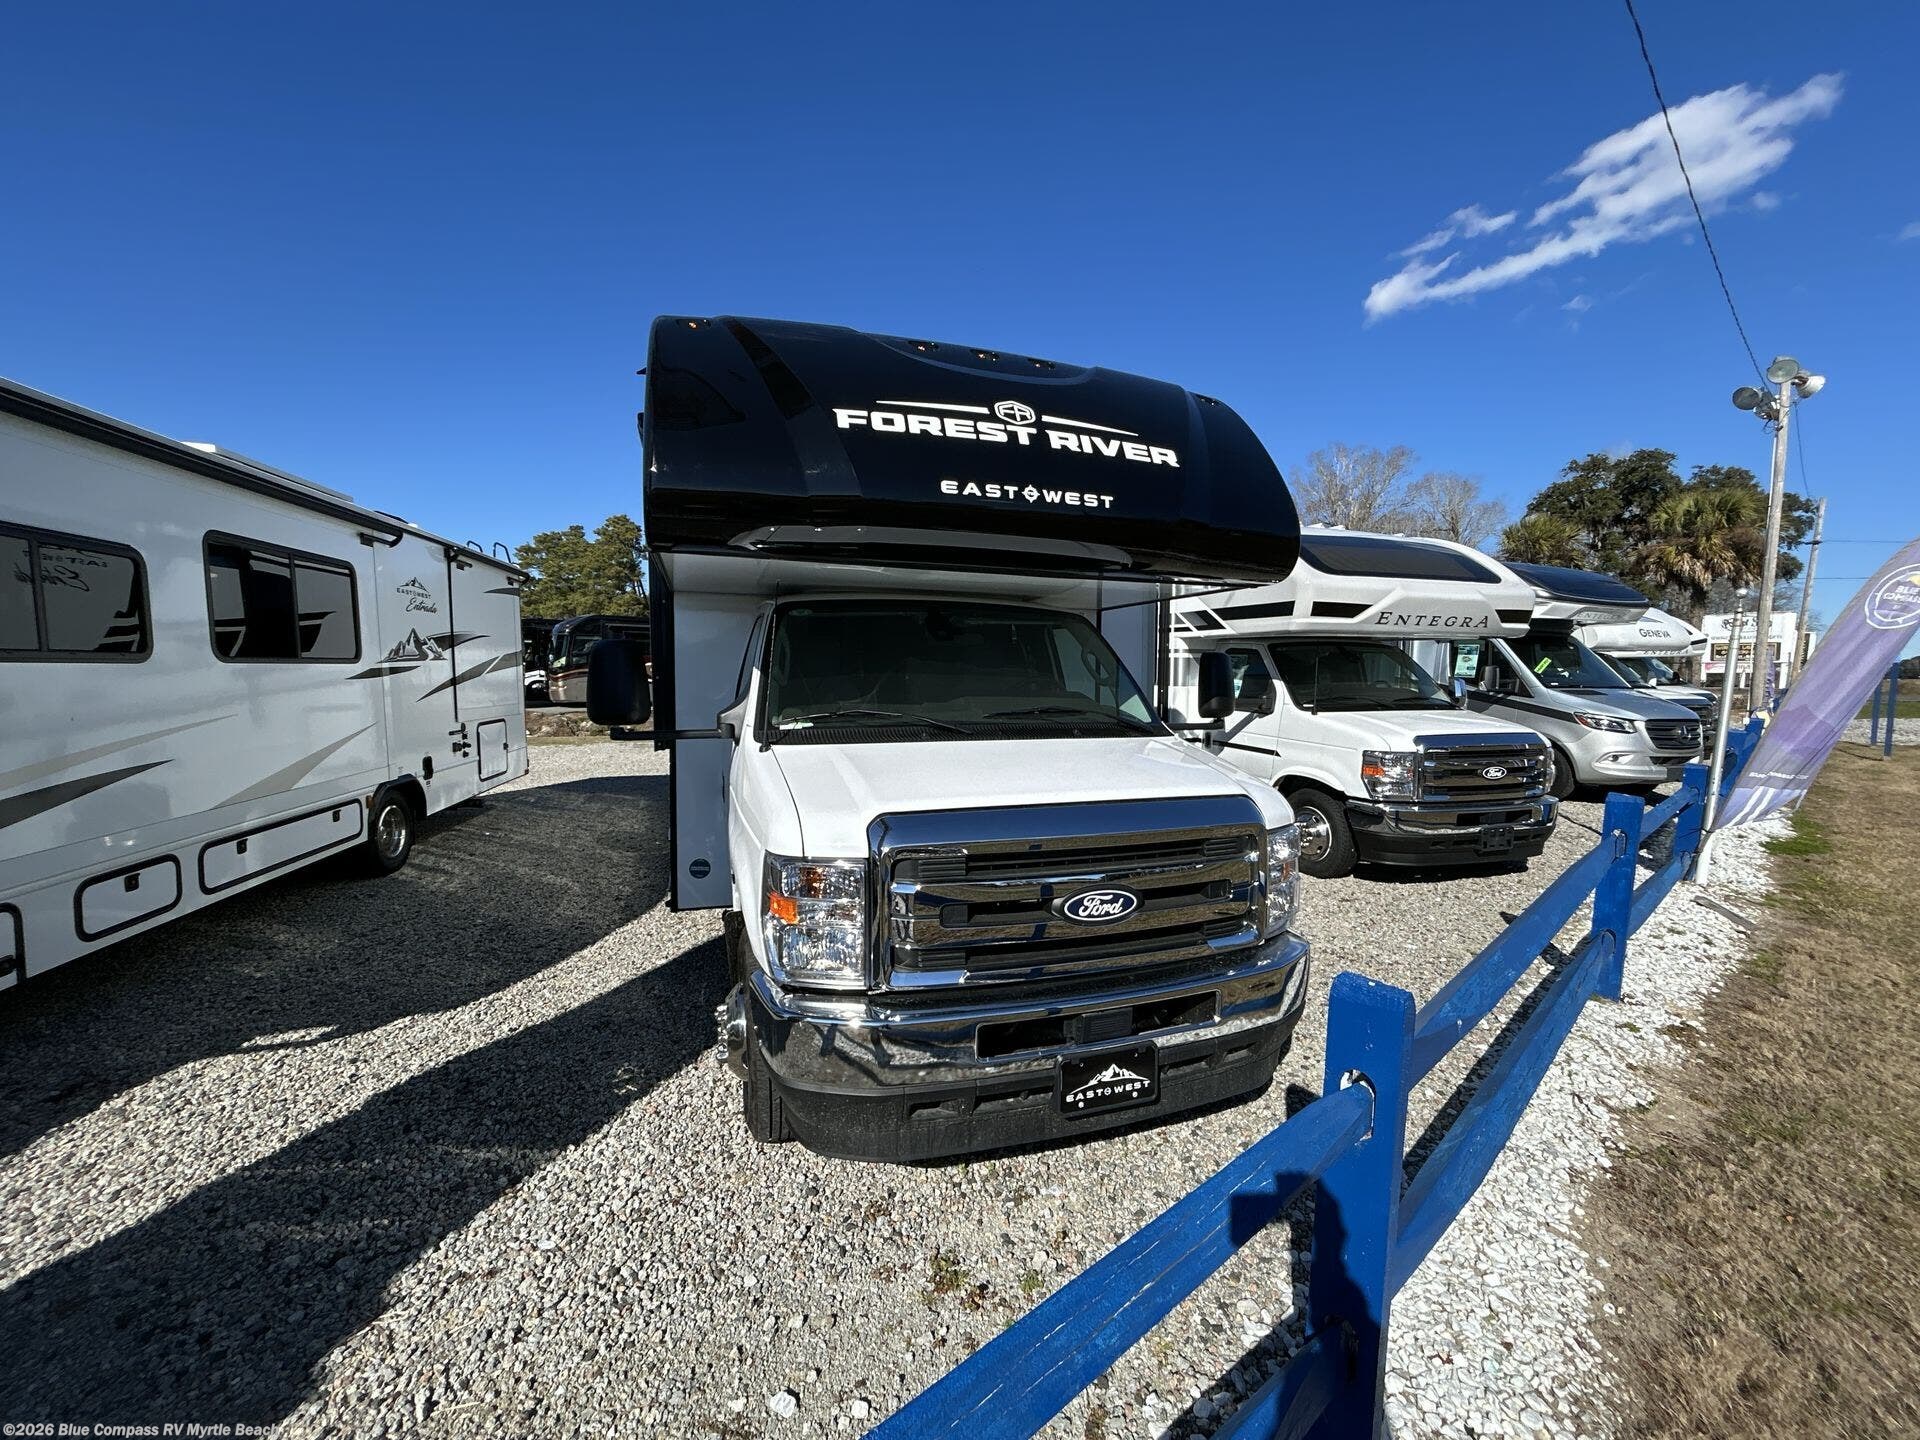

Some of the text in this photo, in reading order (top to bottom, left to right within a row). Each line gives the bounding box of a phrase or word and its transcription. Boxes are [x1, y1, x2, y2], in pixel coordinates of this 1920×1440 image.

[832, 408, 1180, 469] FOREST RIVER
[940, 480, 1114, 508] EAST WEST
[1375, 611, 1489, 628] ENTEGRA
[1639, 628, 1671, 638] GENEVA
[1079, 895, 1124, 916] Ford
[1066, 1081, 1151, 1102] EAST WEST
